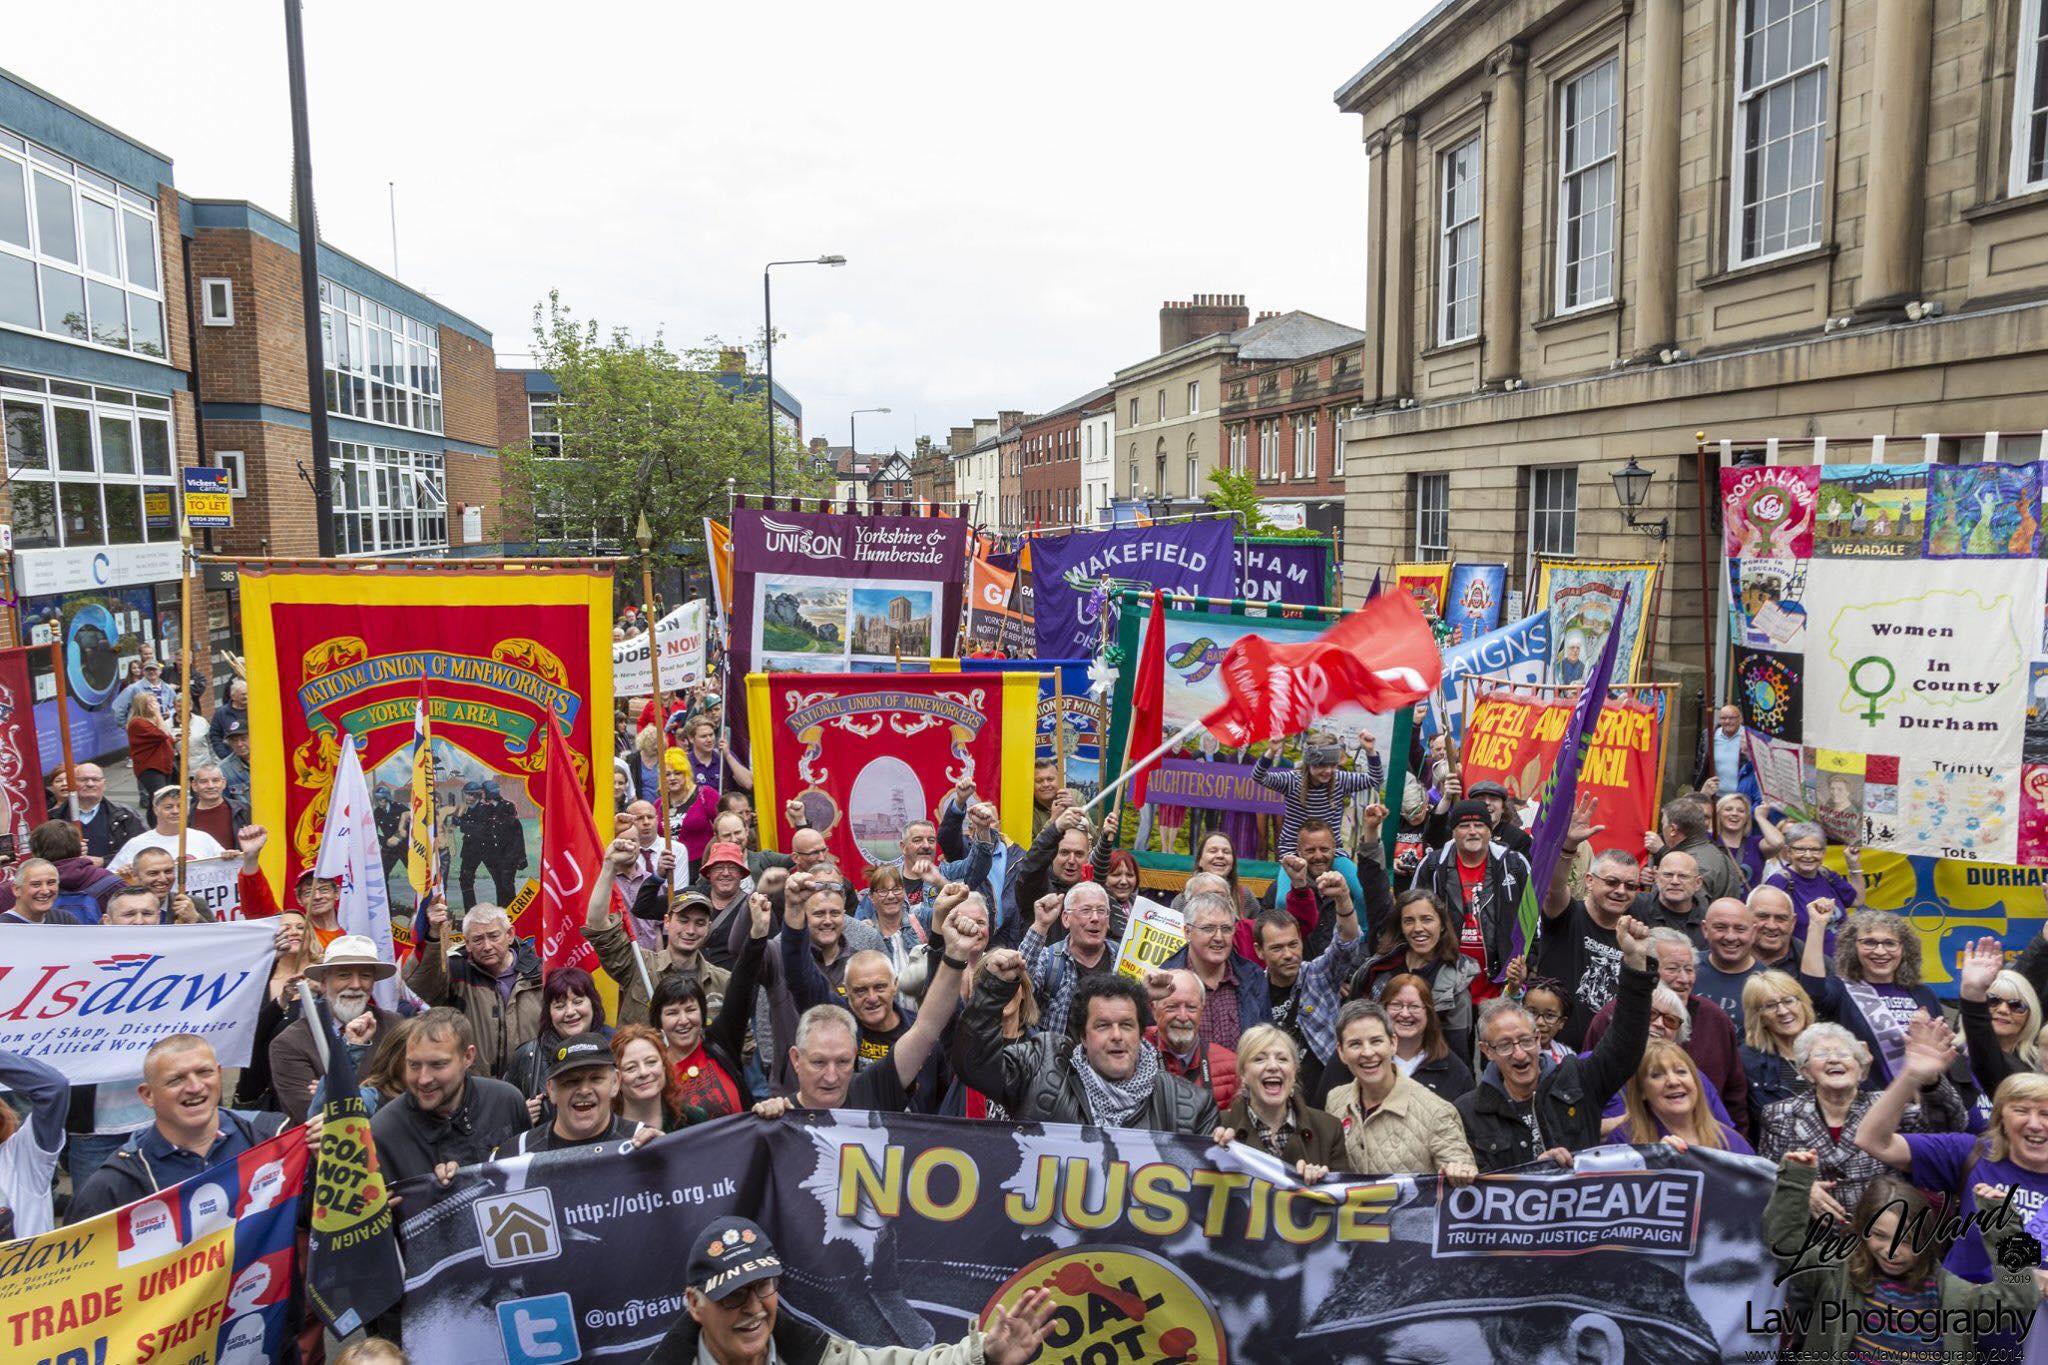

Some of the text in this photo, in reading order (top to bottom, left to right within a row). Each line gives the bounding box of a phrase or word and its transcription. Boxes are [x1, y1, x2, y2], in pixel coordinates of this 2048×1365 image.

[187, 479, 217, 487] Vickers
[1726, 470, 1814, 508] SOCIALISM
[188, 501, 226, 510] TO LET
[766, 531, 843, 557] UNISON
[855, 526, 947, 546] Yorkshire &
[853, 544, 944, 565] Humberside
[1831, 543, 1905, 556] WEARDALE
[1064, 542, 1208, 586] WAKEFIELD
[1748, 565, 1792, 578] EDUCATION
[220, 571, 235, 582] 36
[977, 625, 999, 636] NORTH
[984, 615, 1020, 632] YORKSHIRE
[1872, 623, 1954, 638] Women
[1450, 624, 1548, 680] AIGNS
[1927, 659, 1950, 673] In
[304, 655, 572, 715] NATIONAL UNION OF MINEWORKERS
[1912, 679, 2000, 695] County
[369, 698, 499, 727] YORKSIRE AREA
[792, 694, 981, 729] NATIONAL UNION OF MINEWORKERS
[1899, 715, 1999, 732] Durham
[1933, 760, 1994, 778] Trinity
[1216, 774, 1233, 798] OF
[1941, 847, 1978, 860] Tots
[1143, 927, 1184, 951] TORIES
[1122, 958, 1137, 972] END
[31, 1026, 56, 1044] of
[56, 1025, 111, 1041] Shop,
[119, 1020, 238, 1036] Distributive
[36, 1038, 102, 1057] Allied
[109, 1036, 160, 1052] Work
[317, 1160, 368, 1190] NOT
[316, 1185, 368, 1217] OLE
[564, 1178, 738, 1227] http://otjc.org.uk
[836, 1143, 1400, 1245] NO JUSTICE
[1448, 1181, 1688, 1224] ORGREAVE
[199, 1206, 218, 1217] VOICE
[135, 1217, 160, 1228] ADVICE
[135, 1222, 166, 1236] SUPPORT
[1447, 1225, 1684, 1246] TRUTH AND JUSTICE CAMPAIGN
[0, 1233, 95, 1280] daw
[7, 1239, 227, 1347] TRADE UNION
[25, 1274, 71, 1294] Workers
[135, 1299, 224, 1365] STAFF
